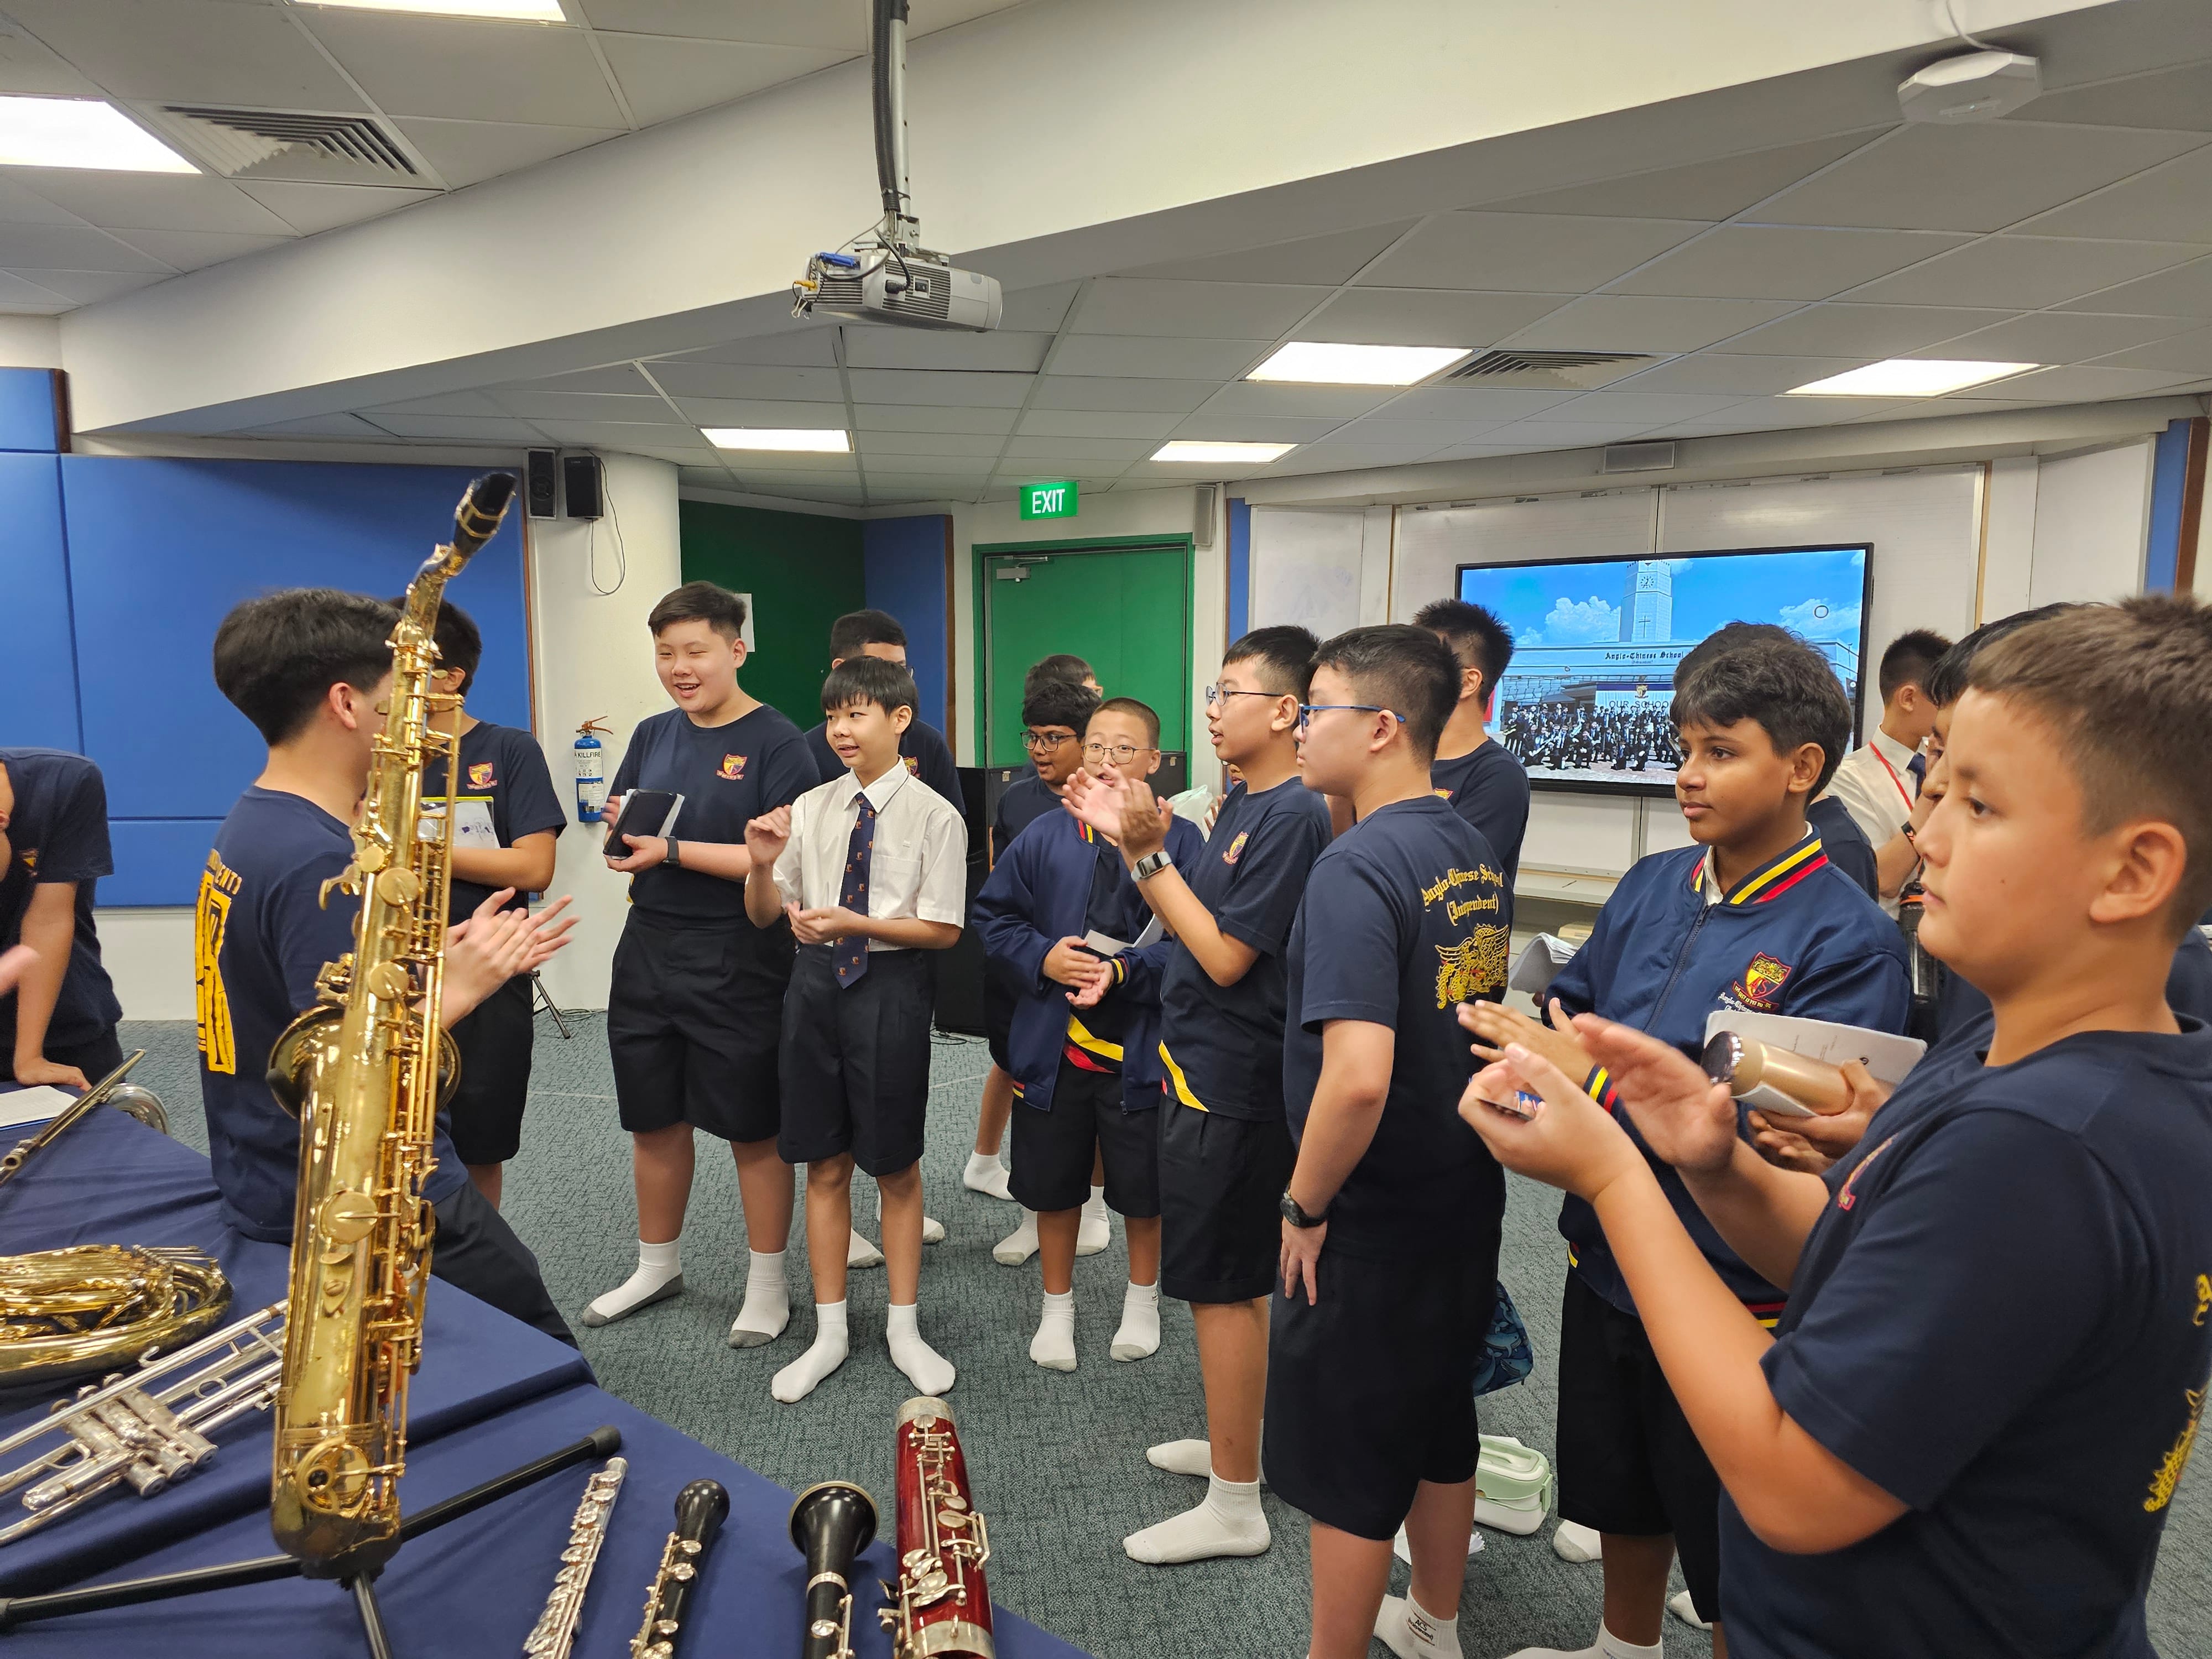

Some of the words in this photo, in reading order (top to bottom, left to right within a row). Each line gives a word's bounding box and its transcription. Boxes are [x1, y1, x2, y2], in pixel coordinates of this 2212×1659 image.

[1032, 489, 1065, 514] EXIT
[1605, 651, 1656, 660] Anglo-Chinese
[1660, 651, 1683, 660] School
[1415, 1619, 1427, 1631] ACS
